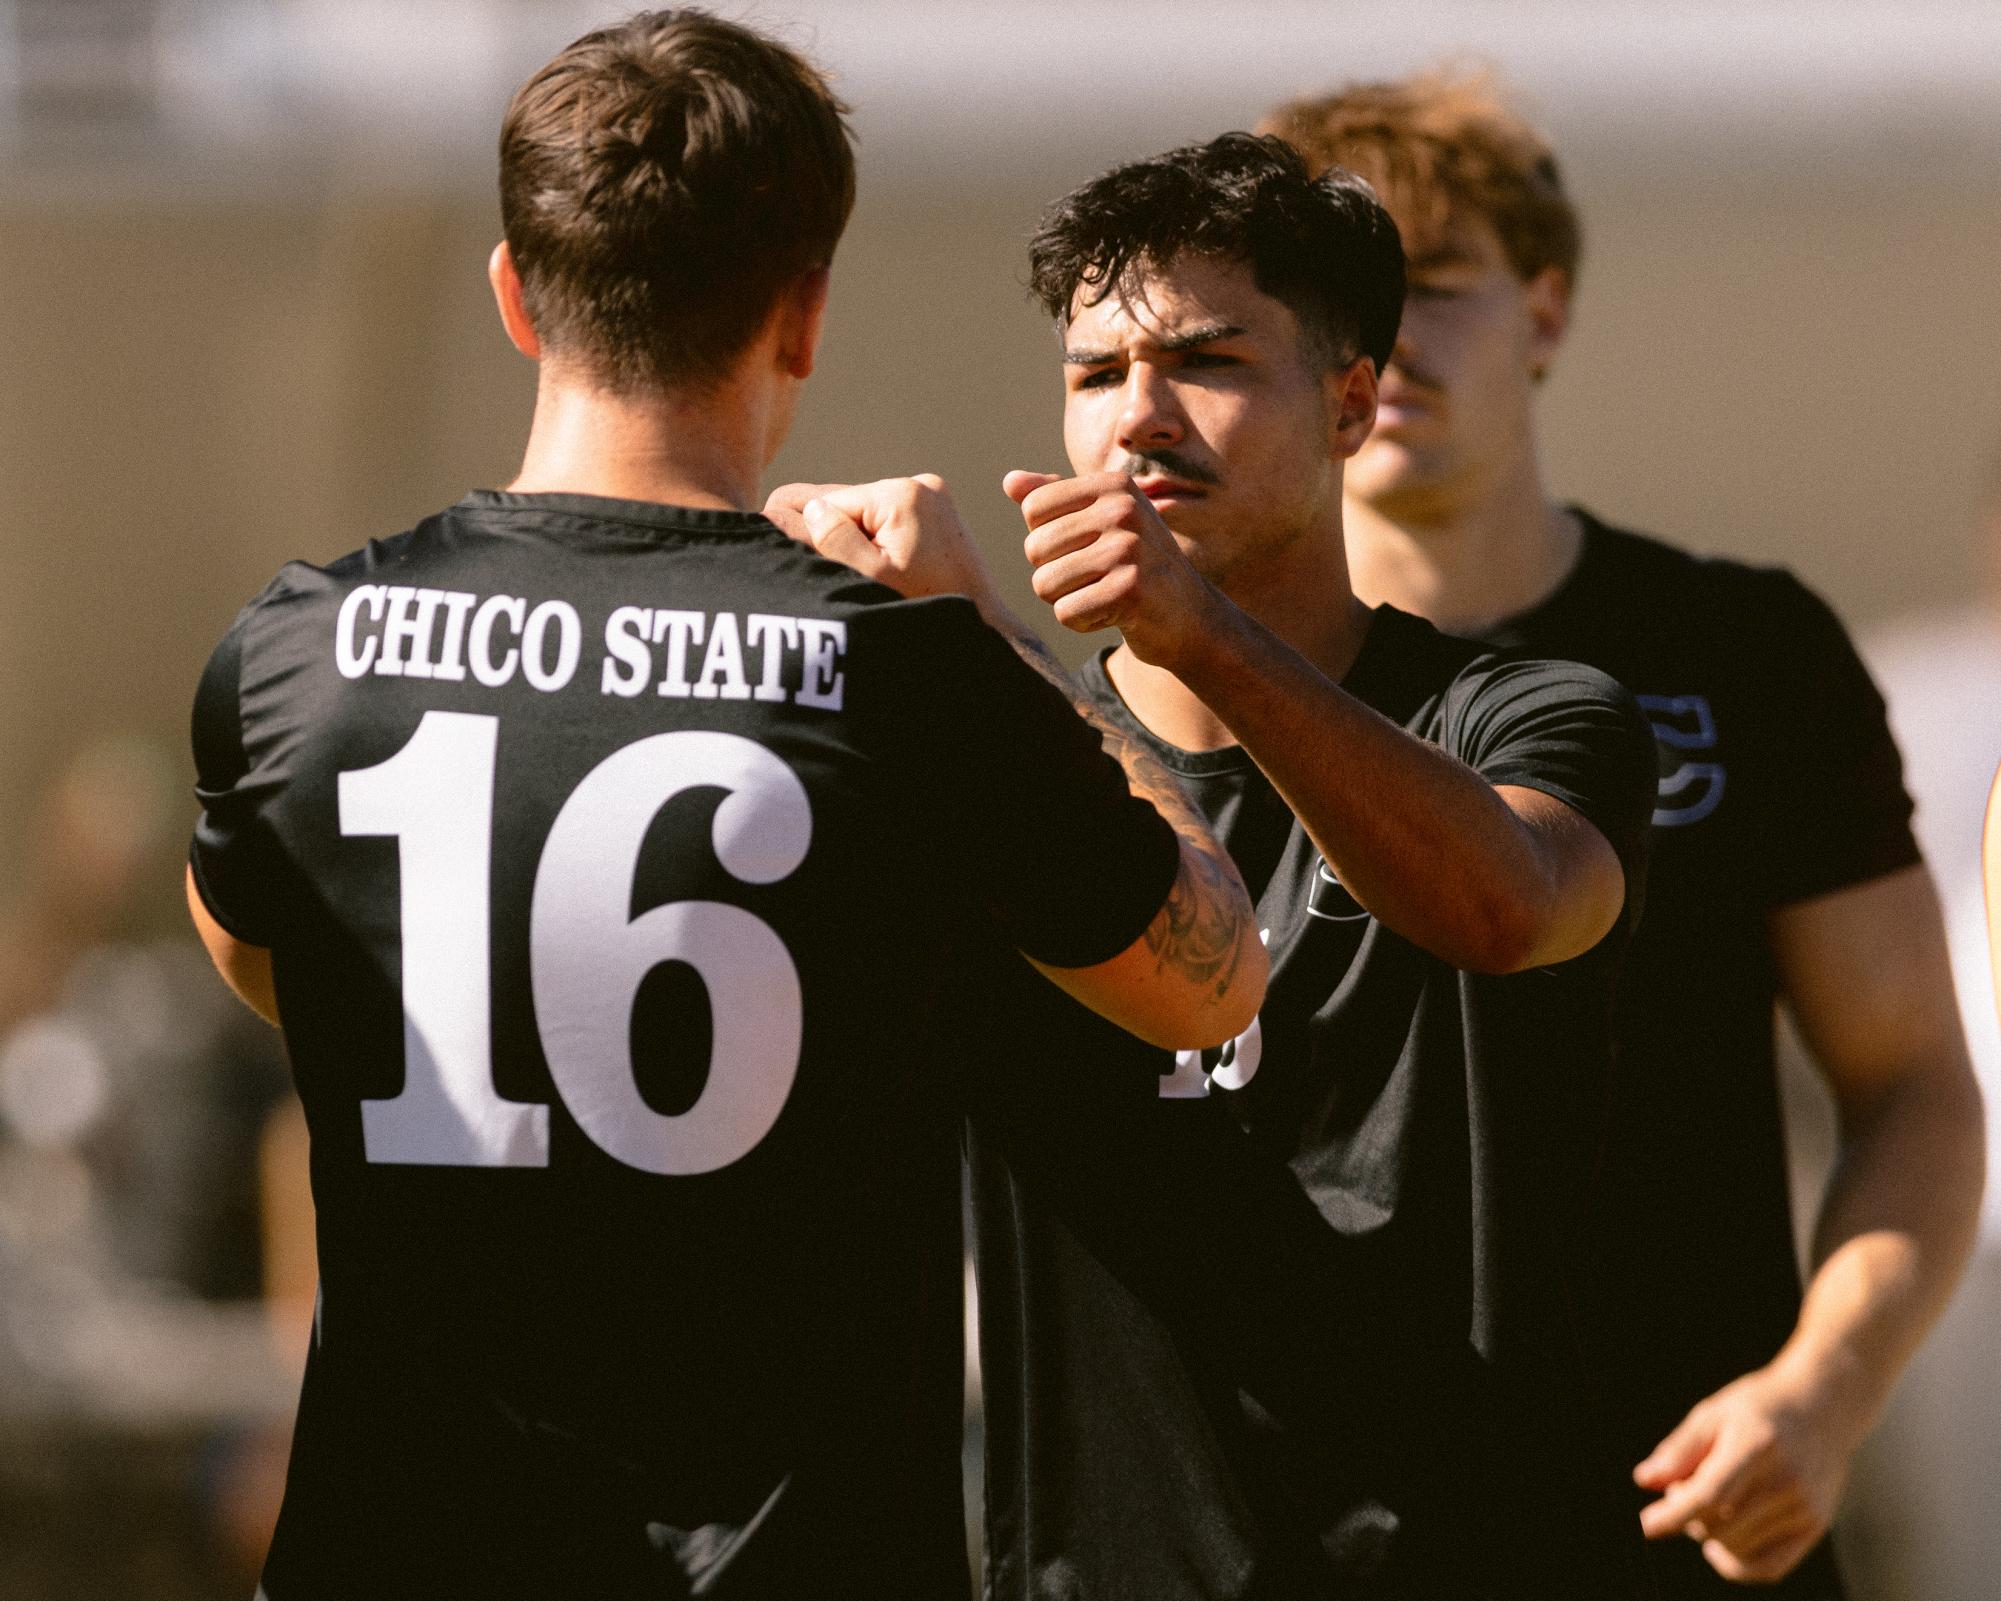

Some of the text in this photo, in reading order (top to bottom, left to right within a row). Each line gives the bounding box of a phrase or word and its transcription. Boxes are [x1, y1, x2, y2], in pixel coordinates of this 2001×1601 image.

[335, 584, 847, 711] CHICO STATE
[337, 710, 813, 1176] 16
